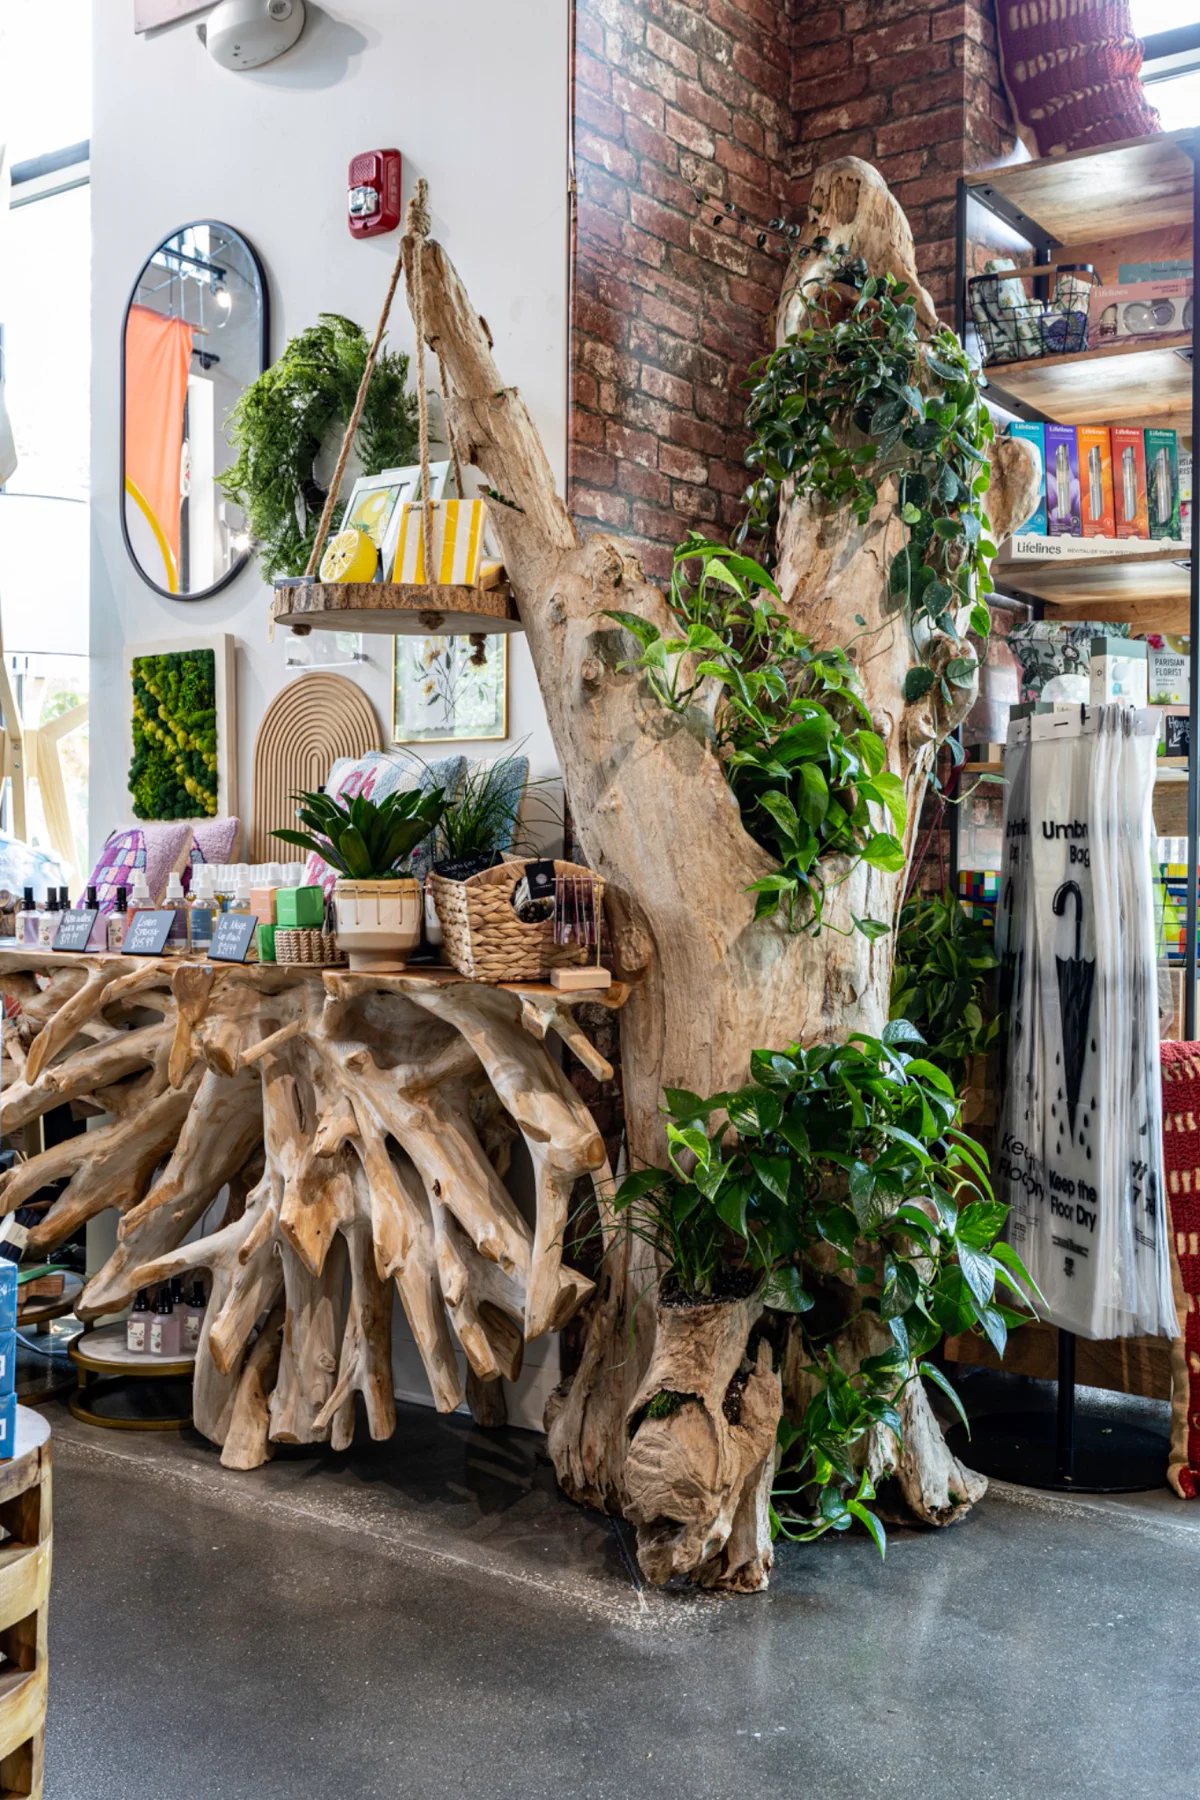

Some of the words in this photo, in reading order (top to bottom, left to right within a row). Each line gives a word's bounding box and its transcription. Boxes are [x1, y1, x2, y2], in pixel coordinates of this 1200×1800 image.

[1094, 288, 1128, 298] Lifelines
[1017, 541, 1062, 555] Lifelines
[1154, 658, 1185, 666] PARISIAN
[1155, 667, 1182, 676] FLORIST
[1069, 844, 1090, 868] Bag
[1049, 1169, 1075, 1199] Keep
[1077, 1178, 1097, 1204] the
[1050, 1194, 1074, 1221] Floor
[1076, 1203, 1097, 1233] Dry
